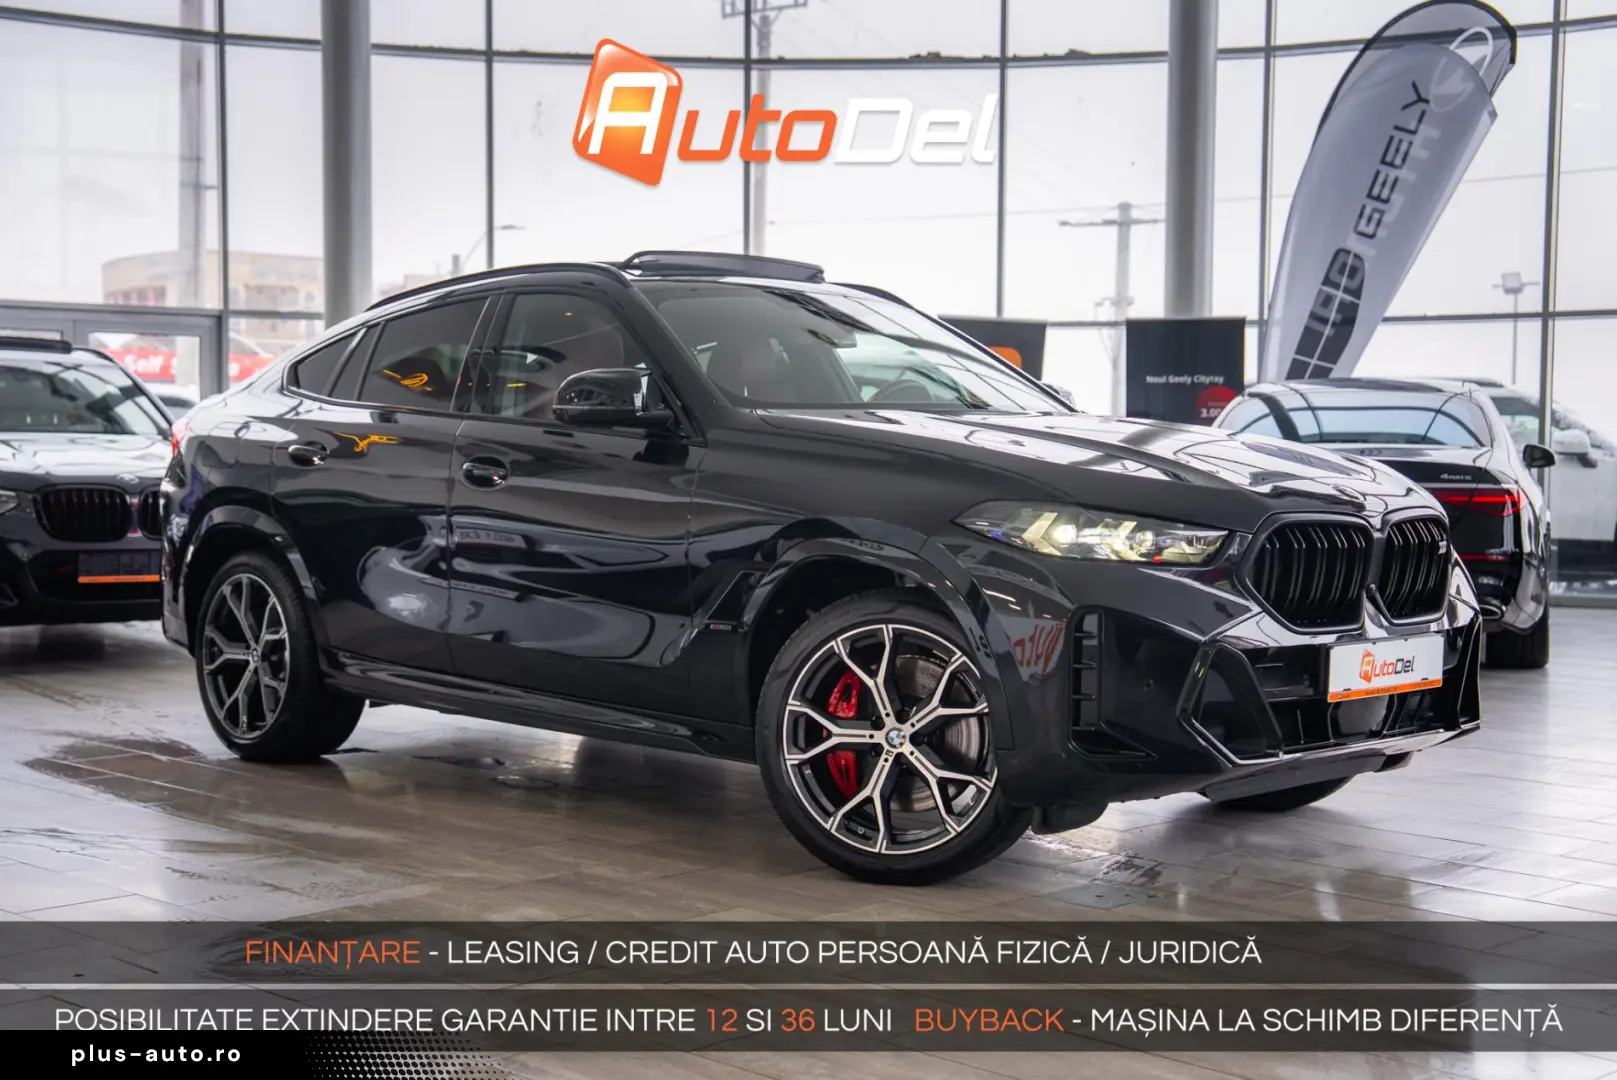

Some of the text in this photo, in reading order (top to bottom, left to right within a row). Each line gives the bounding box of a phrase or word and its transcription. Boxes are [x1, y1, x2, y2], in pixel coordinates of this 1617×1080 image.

[1353, 79, 1431, 240] GEELY
[1167, 374, 1192, 385] Geely
[1360, 652, 1415, 678] AutoDel
